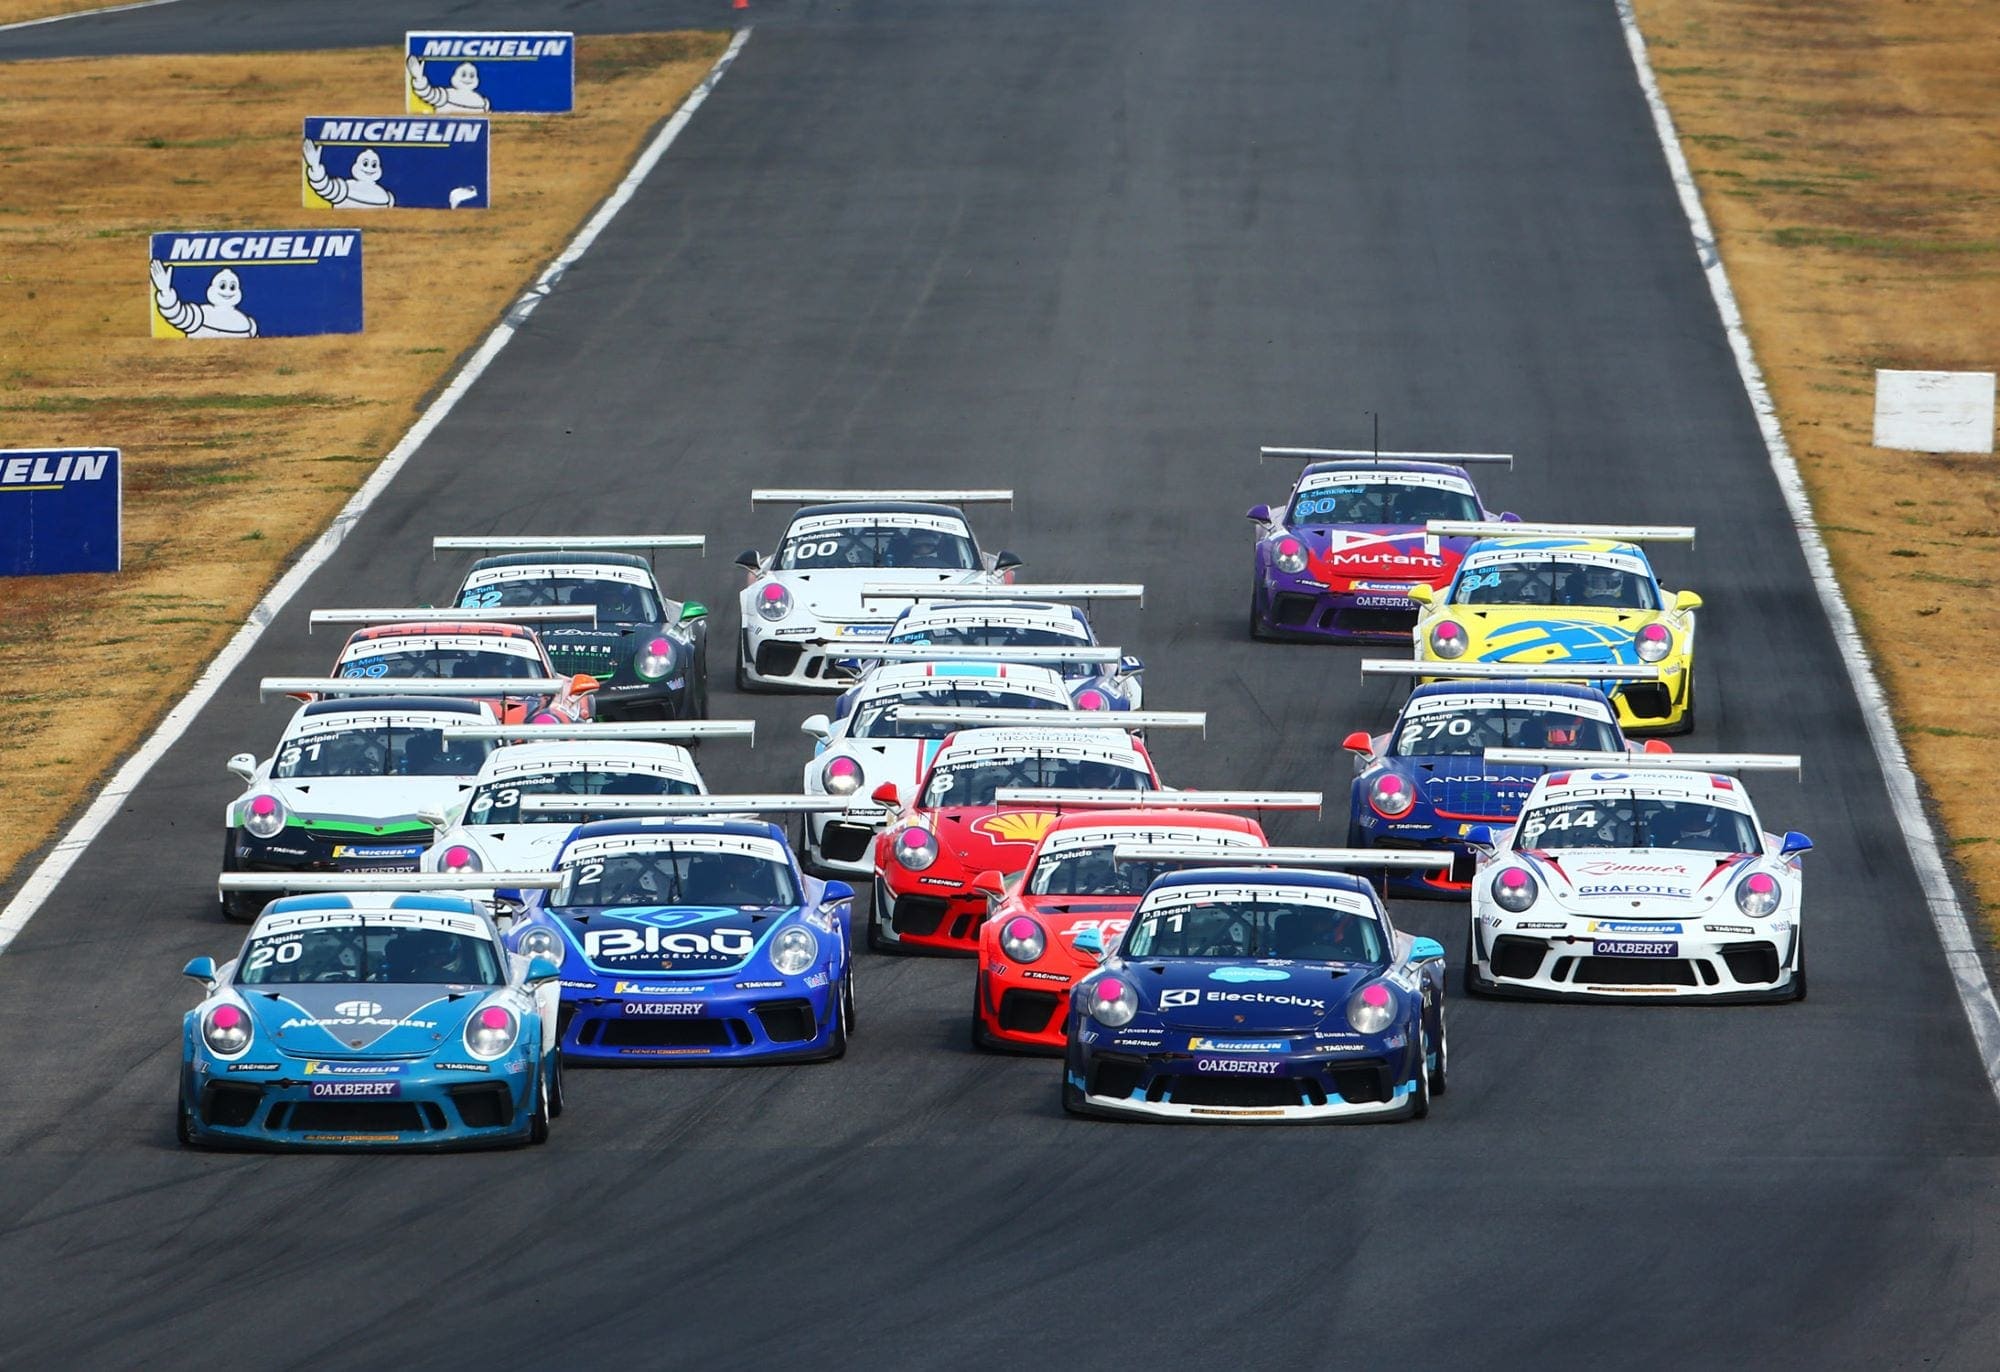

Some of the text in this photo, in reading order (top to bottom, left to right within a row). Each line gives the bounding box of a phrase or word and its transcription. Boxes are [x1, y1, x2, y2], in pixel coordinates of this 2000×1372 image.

[424, 40, 567, 57] MICHELIN
[319, 121, 482, 143] MICHELIN
[169, 235, 355, 261] MICHELIN
[0, 456, 109, 483] ELIN
[1311, 474, 1464, 489] PORSCHE
[1295, 498, 1335, 518] 80
[784, 541, 838, 561] 100
[1333, 553, 1443, 568] Mutant
[1474, 552, 1638, 569] PORSCHE
[476, 569, 642, 582] PORSCHE
[1462, 572, 1502, 592] 34
[461, 591, 503, 608] 52
[904, 617, 1075, 632] PORSCHE
[354, 640, 529, 653] PORSCHE
[548, 645, 611, 654] NEWEN
[876, 680, 1056, 697] PORSCHE
[1418, 699, 1600, 715] PORSCHE
[1400, 719, 1472, 744] 270
[279, 743, 322, 767] 31
[947, 746, 1134, 764] PORSCHE
[494, 760, 685, 776] PORSCHE
[936, 767, 950, 775] W.
[931, 773, 955, 794] 8
[1425, 776, 1538, 784] ANDBAN
[471, 789, 521, 813] 63
[1545, 788, 1739, 806] PORSCHE
[1530, 811, 1544, 819] M.
[1523, 810, 1598, 838] 544
[574, 838, 774, 855] PORSCHE
[576, 856, 605, 868] Hahn
[1039, 849, 1093, 865] M. Paludo
[561, 863, 605, 889] 12
[1579, 885, 1691, 895] GRAFOTEC
[1154, 889, 1361, 909] PORSCHE
[268, 914, 477, 931] PORSCHE
[1142, 914, 1184, 937] 11
[266, 933, 304, 946] Aguiar
[250, 942, 303, 970] 20
[1597, 942, 1673, 955] OAKBERRY
[1207, 991, 1325, 1009] Electrolux
[625, 1002, 703, 1016] OAKBERRY
[280, 1017, 438, 1029] Alvaro Aguiar
[1198, 1059, 1280, 1074] OAKBERRY
[313, 1082, 396, 1096] OAKBERRY
